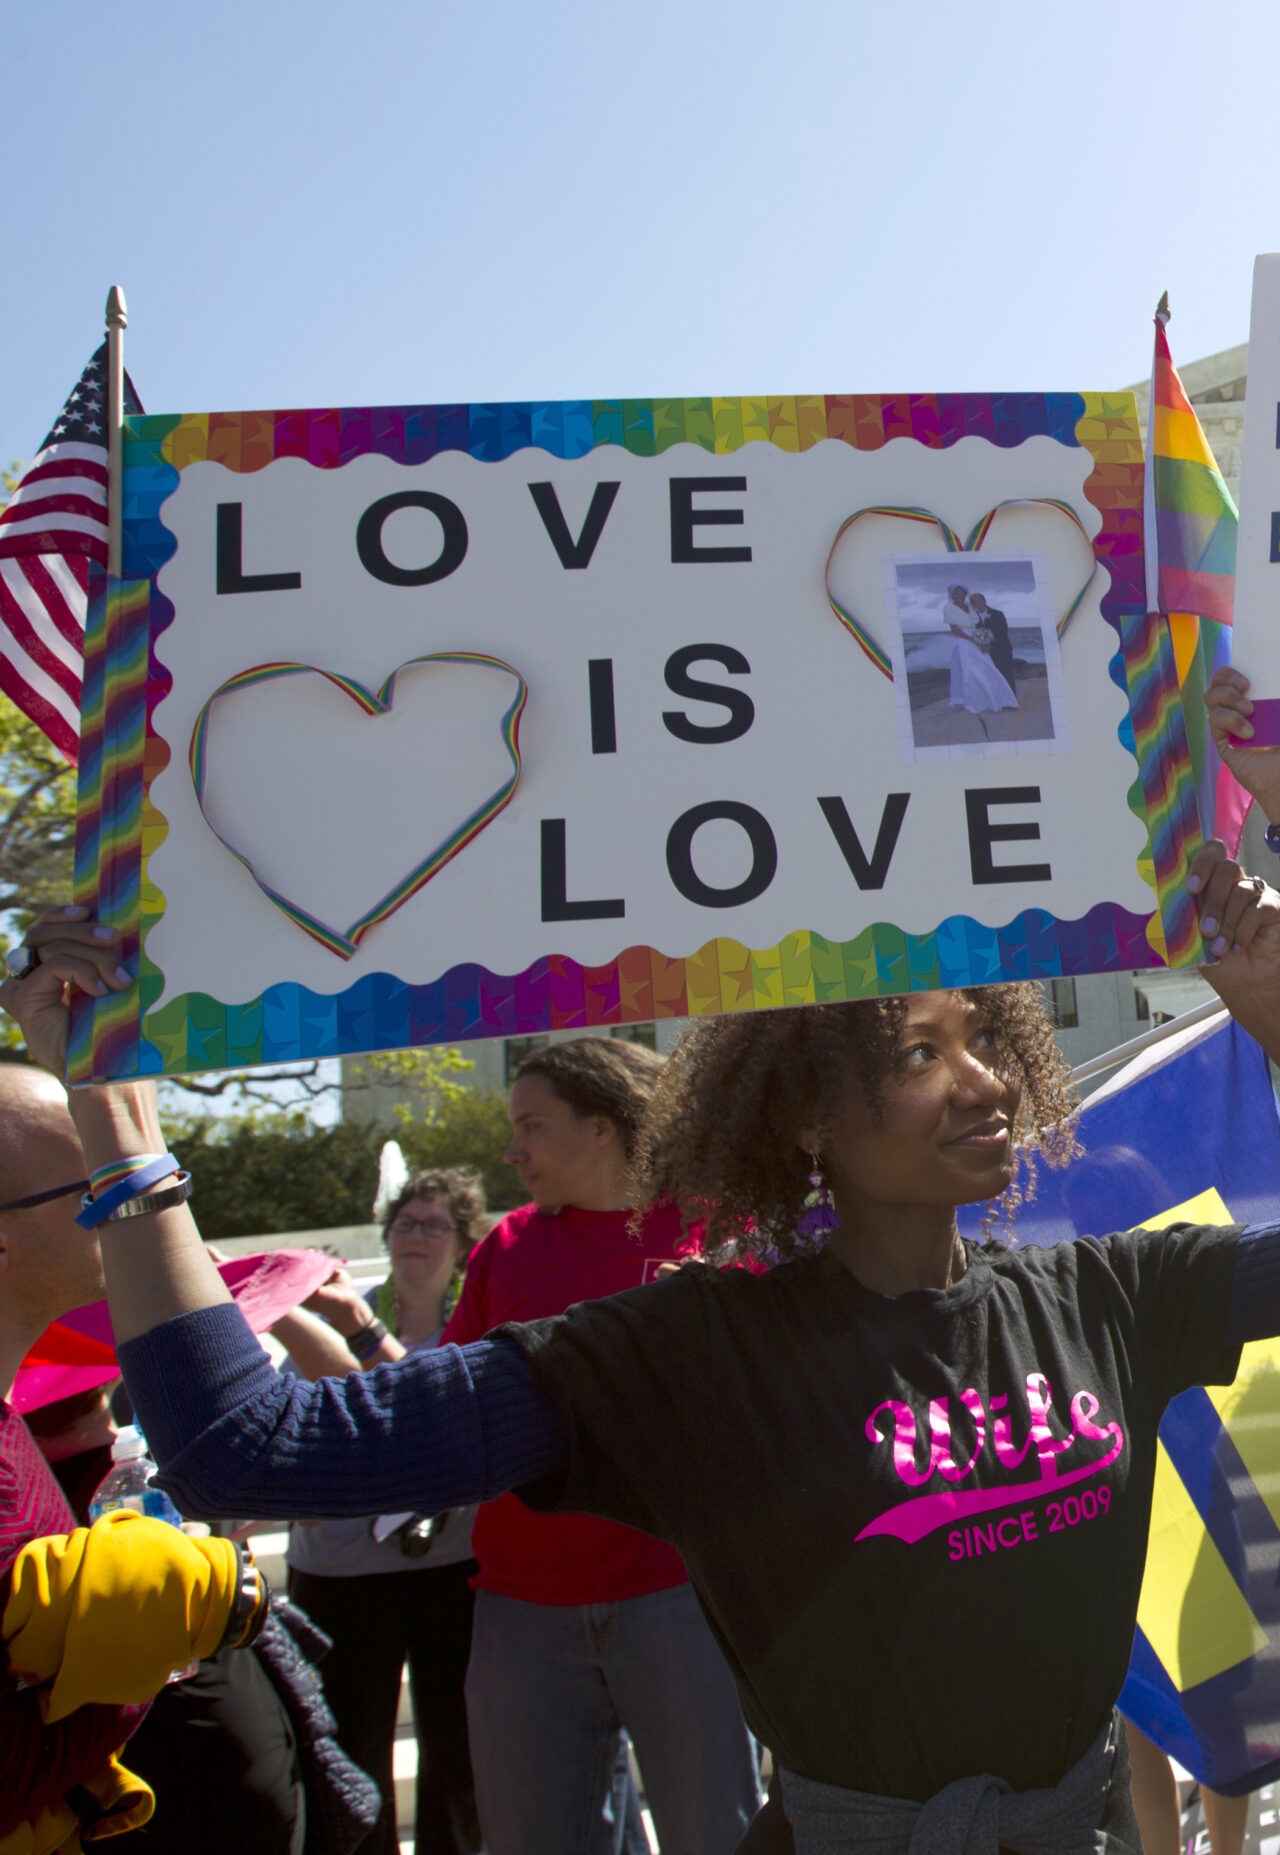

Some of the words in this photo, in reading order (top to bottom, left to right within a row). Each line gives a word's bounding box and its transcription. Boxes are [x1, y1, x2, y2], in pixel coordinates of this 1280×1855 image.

[216, 475, 754, 595] LOVE
[588, 643, 756, 754] IS
[540, 786, 1053, 923] LOVE
[864, 1372, 1124, 1488] Wife
[947, 1510, 1039, 1561] SINCE
[1045, 1485, 1113, 1533] 2009
